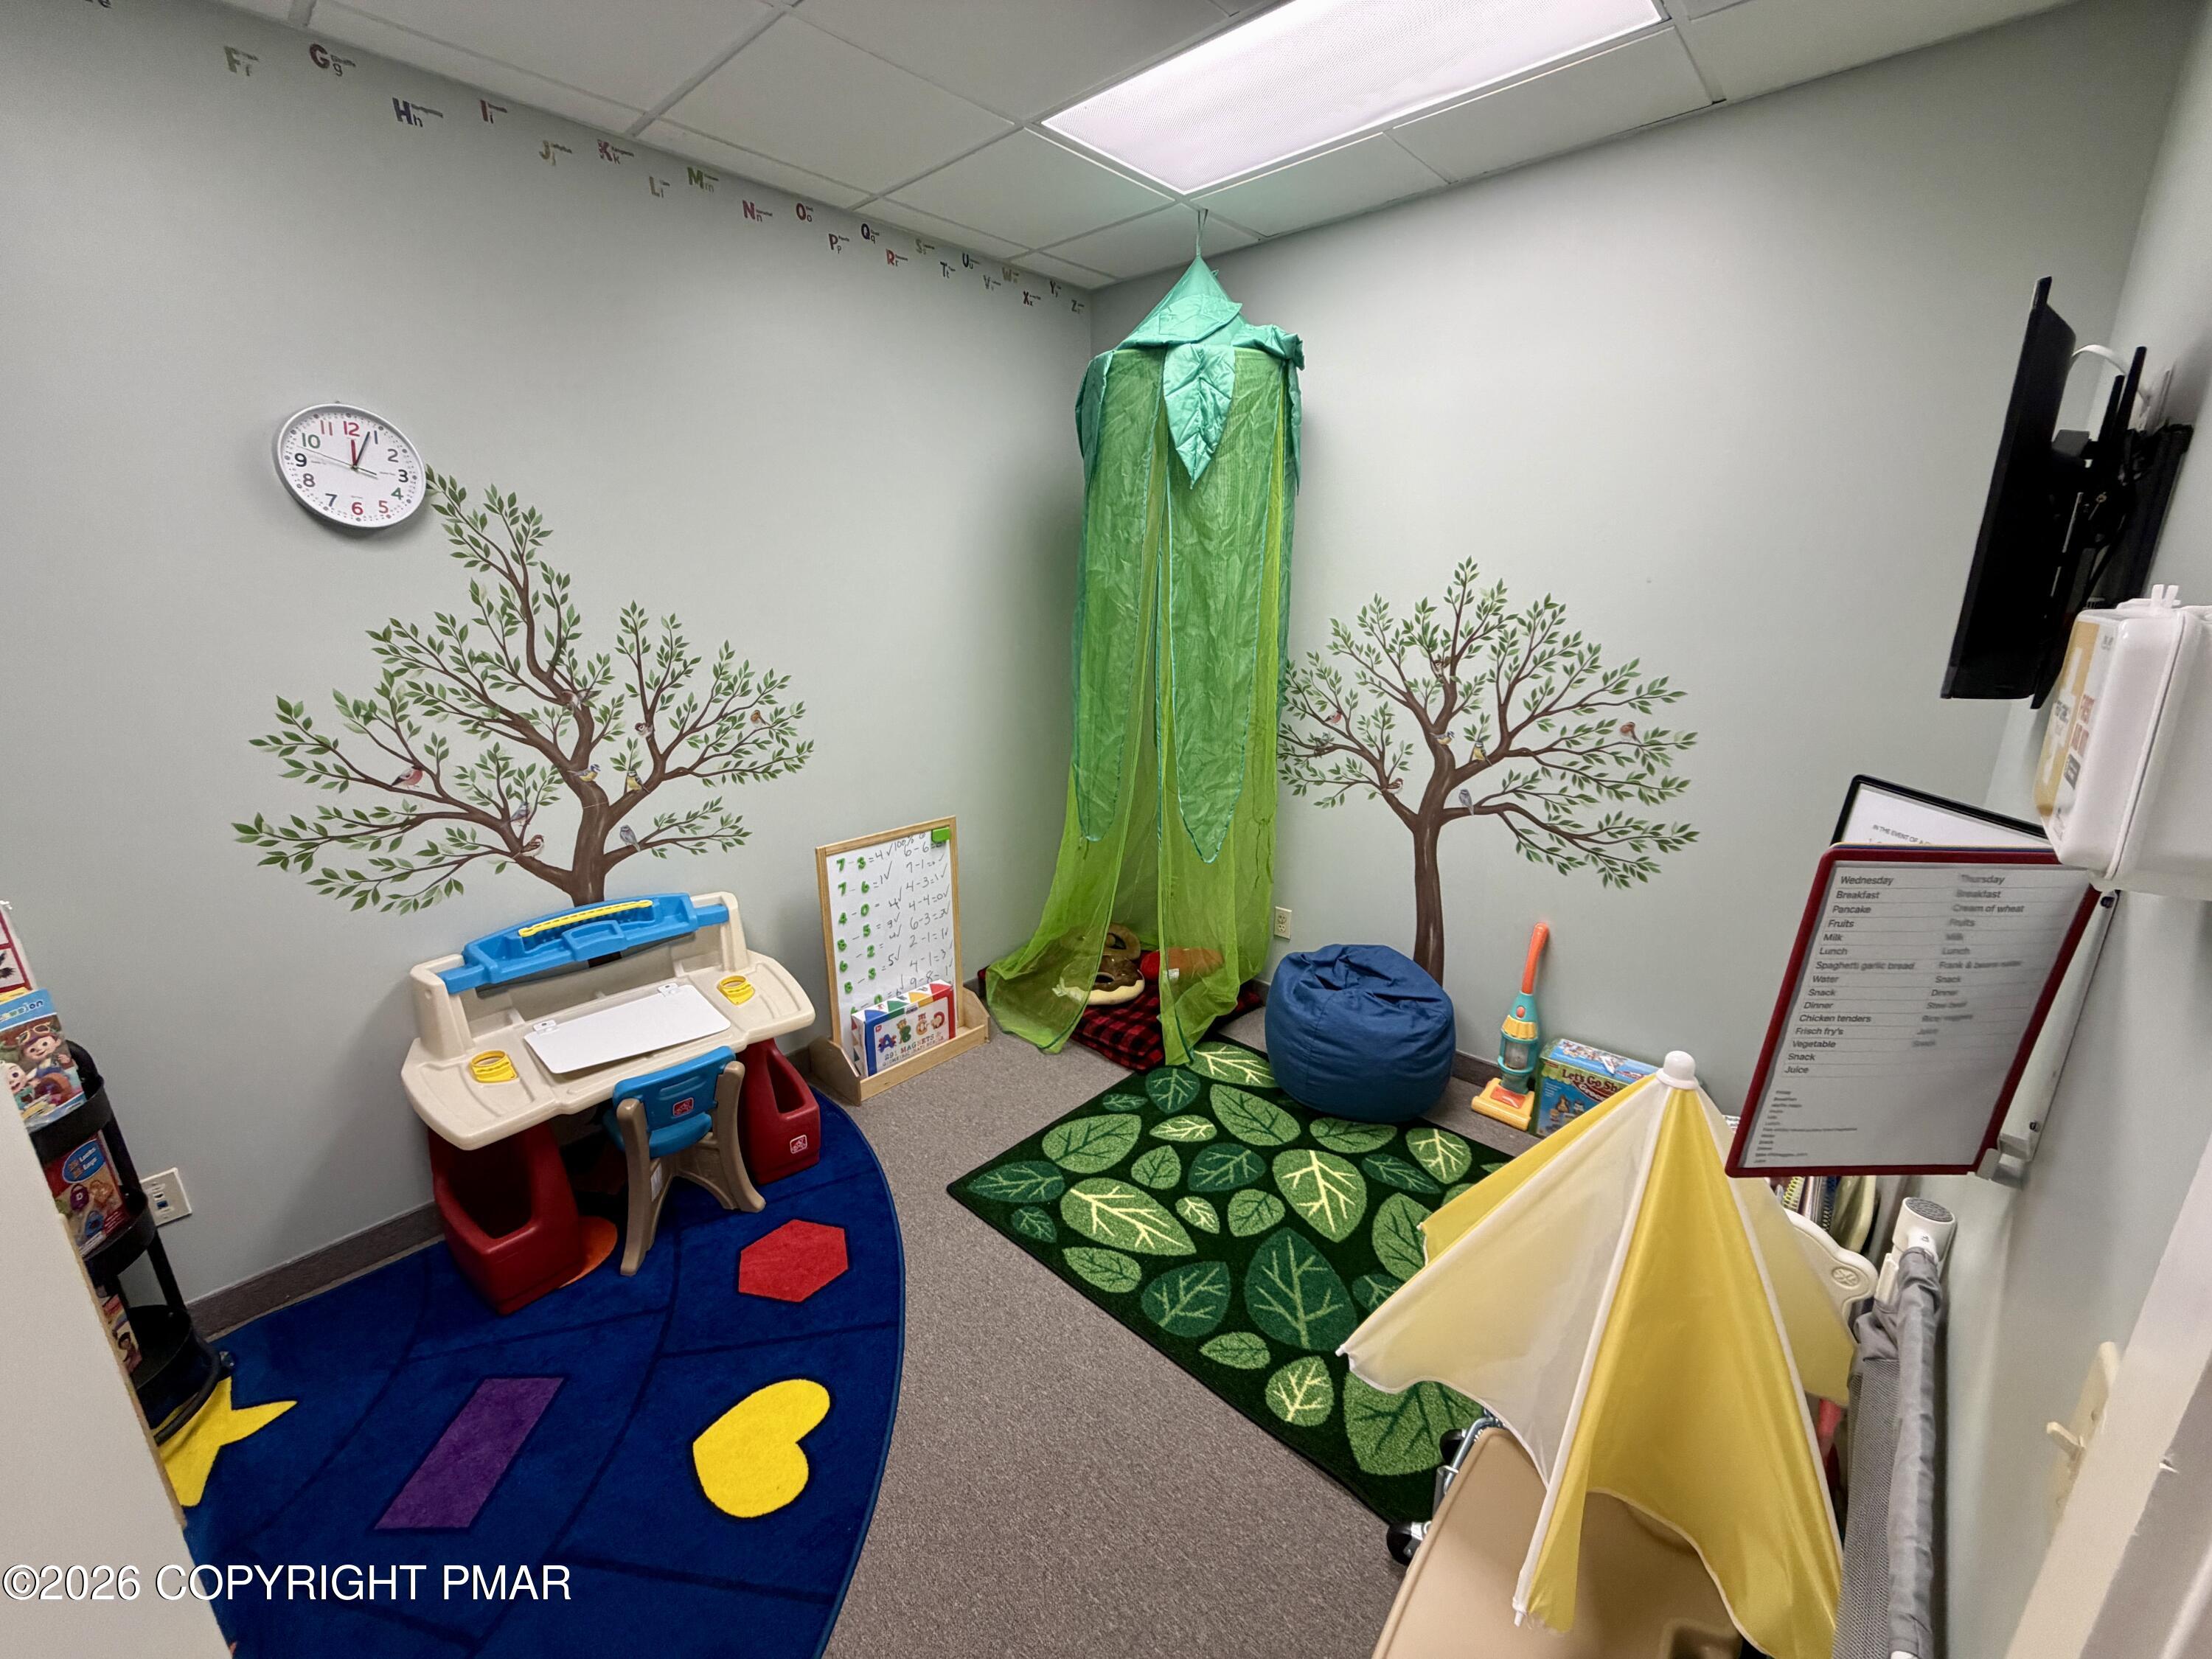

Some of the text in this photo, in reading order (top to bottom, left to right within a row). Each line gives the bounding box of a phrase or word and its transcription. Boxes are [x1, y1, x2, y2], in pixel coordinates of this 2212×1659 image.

[321, 420, 333, 436] 11
[344, 421, 360, 437] 12
[302, 433, 320, 448] 10
[294, 453, 307, 467] 9
[388, 448, 398, 462] 2
[303, 473, 315, 487] 8
[398, 469, 408, 482] 3
[325, 493, 337, 507] 7
[391, 487, 403, 500] 4
[352, 501, 364, 515] 6
[378, 500, 389, 513] 5
[1891, 830, 1910, 840] EVENT
[836, 858, 845, 872] 7
[875, 850, 884, 860] 4
[1840, 876, 1893, 886] Wednesday
[1961, 874, 2005, 885] Thursday
[838, 881, 847, 896] 7
[861, 880, 870, 894] 6
[1956, 889, 2001, 897] Breakfast
[1836, 891, 1880, 899] Breakfast
[860, 903, 870, 917] 0
[888, 898, 900, 910] 4
[1832, 905, 1871, 914] Pancake
[1828, 919, 1854, 928] Fruits
[1815, 961, 1859, 970] Spaghetti
[1824, 1028, 1843, 1036] fry's
[1792, 1040, 1836, 1048] Vegetable
[1787, 1053, 1815, 1061] Snack
[1784, 1065, 1809, 1074] Juice
[1562, 1068, 1585, 1082] Let's
[1587, 1076, 1601, 1088] Go
